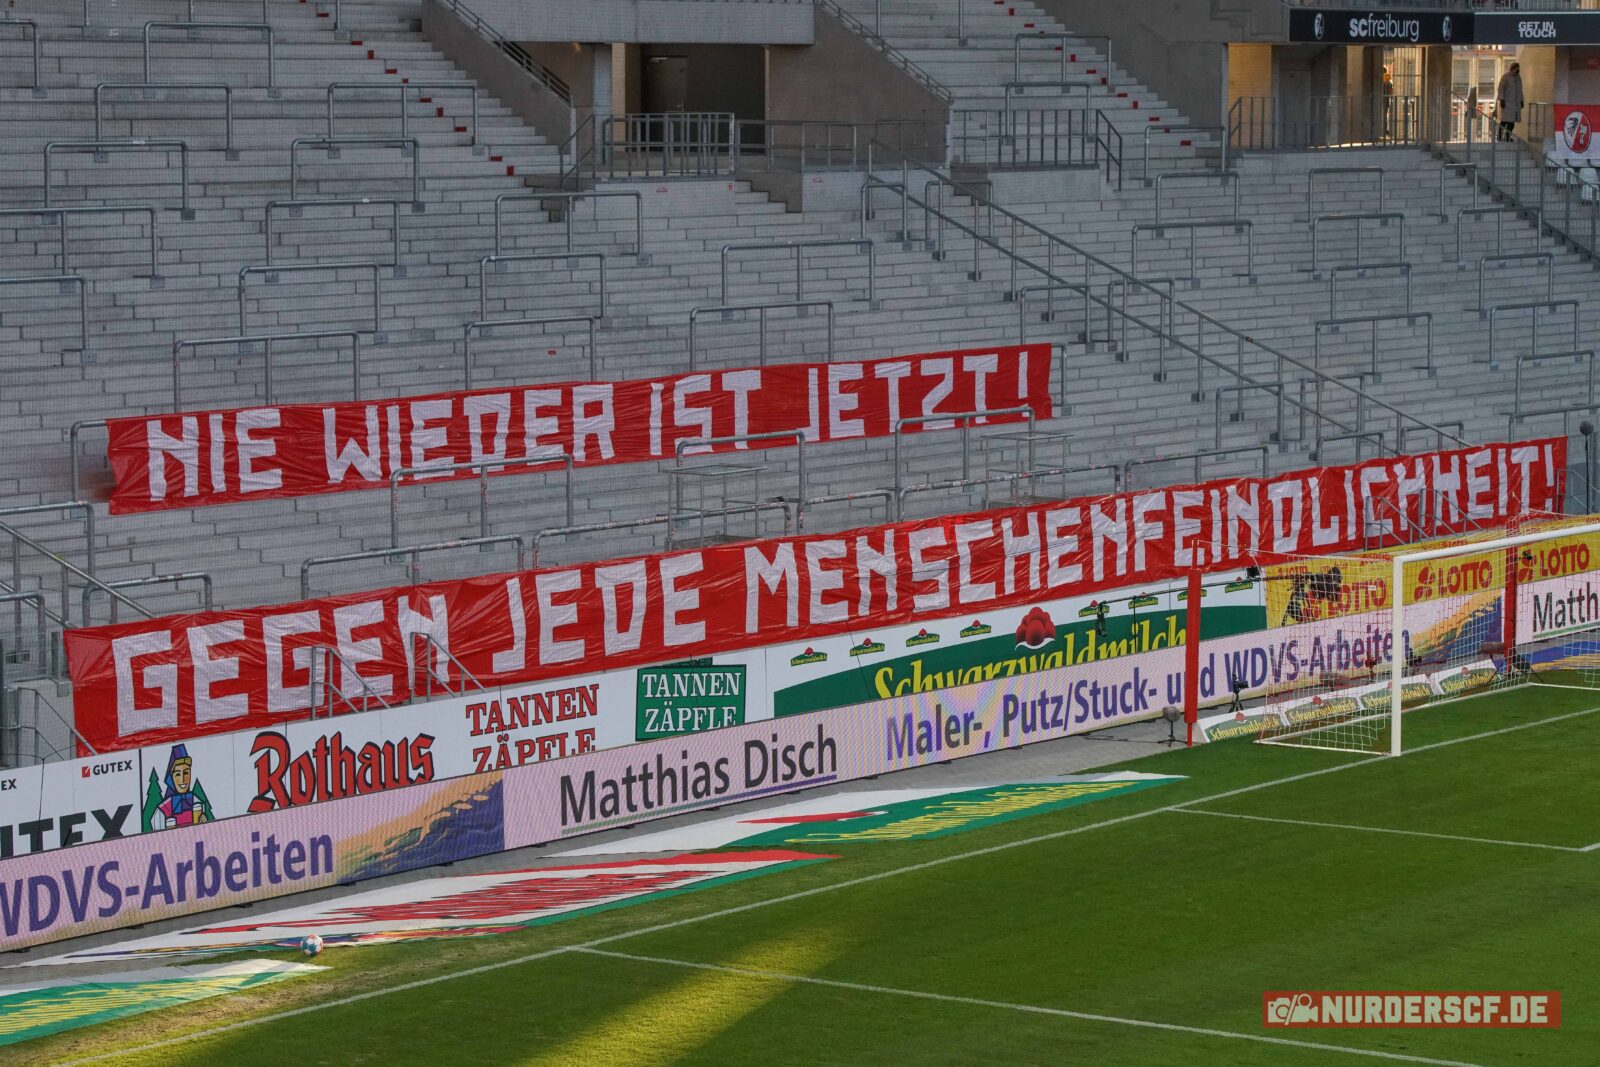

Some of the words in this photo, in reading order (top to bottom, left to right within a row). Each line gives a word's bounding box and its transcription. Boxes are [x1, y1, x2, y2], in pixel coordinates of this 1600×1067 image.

[1350, 13, 1419, 42] scfreiburg
[1518, 21, 1540, 31] GET
[1541, 21, 1554, 31] IN
[1519, 29, 1556, 38] TOUCH
[146, 408, 283, 502] NIE
[322, 383, 615, 485] WIEDER
[649, 369, 763, 456] IST
[1438, 560, 1493, 596] LOTTO
[1540, 543, 1591, 577] LOTTO
[111, 594, 451, 737] GEGEN
[492, 551, 707, 674] JEDE
[642, 672, 742, 698] TANNEN
[1003, 666, 1158, 738] Putz/Stuck-
[1167, 653, 1215, 705] ud
[465, 683, 600, 737] TANNEN
[645, 700, 737, 733] ZÄPFLE
[92, 759, 133, 776] GUTEX
[472, 727, 596, 774] ZÄPFLE
[247, 731, 436, 811] Rothaus
[560, 750, 730, 826] Matthias
[744, 724, 838, 789] Disch
